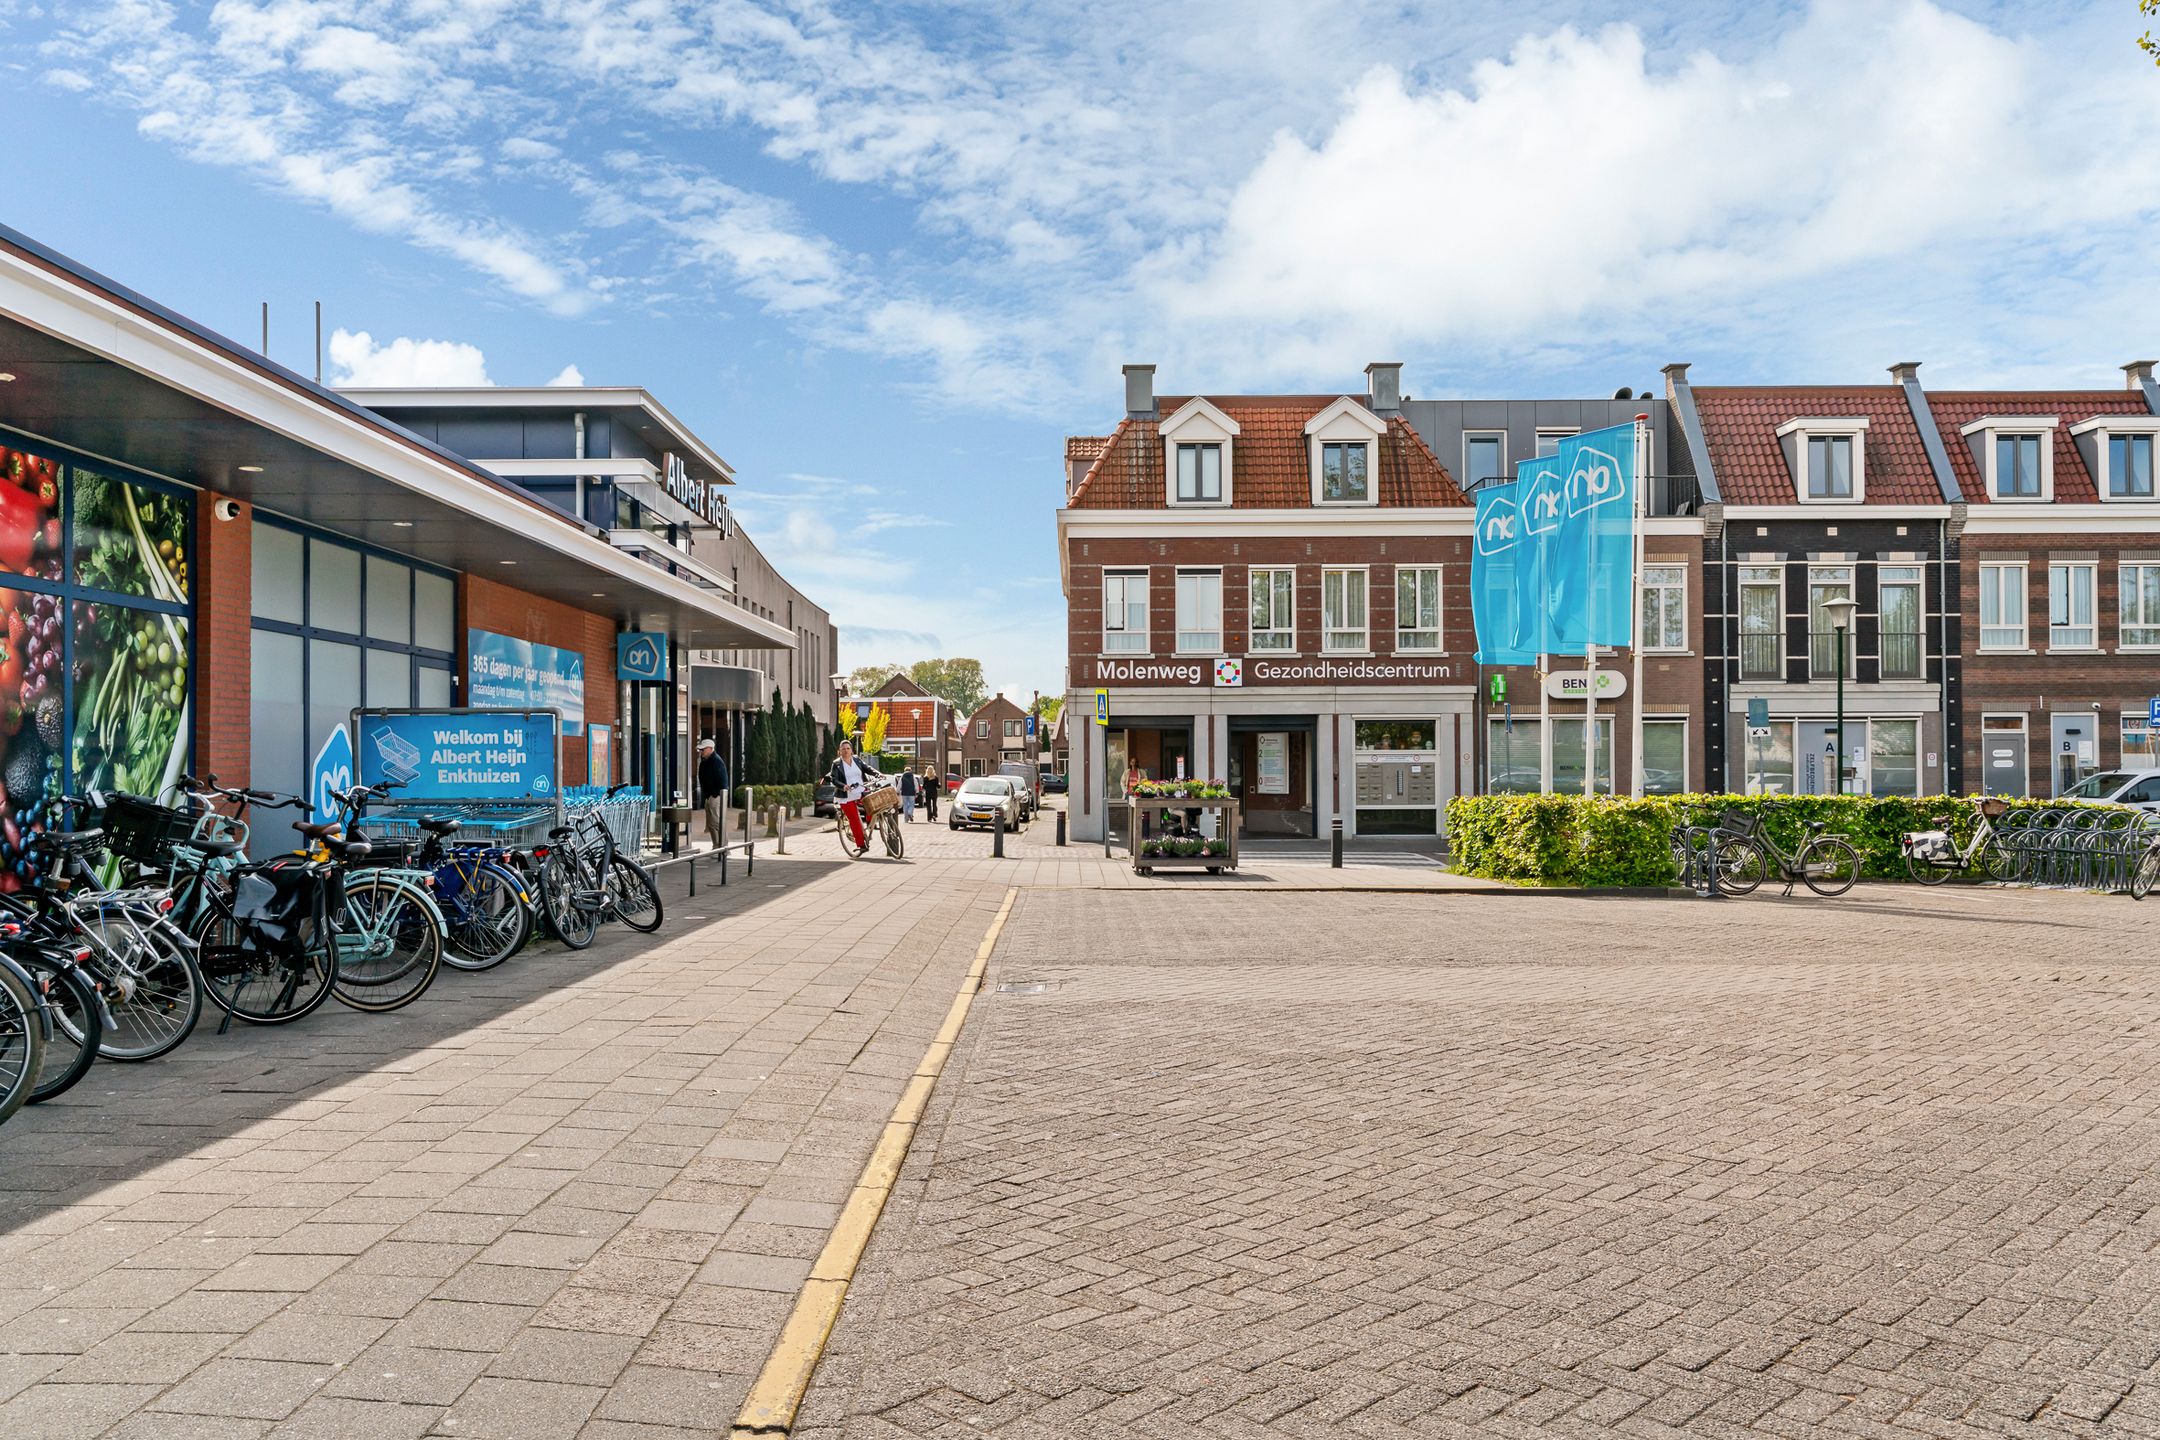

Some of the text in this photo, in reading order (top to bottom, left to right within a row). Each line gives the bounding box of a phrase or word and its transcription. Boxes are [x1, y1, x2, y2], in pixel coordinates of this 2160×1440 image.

[665, 452, 705, 517] Albert
[473, 654, 564, 687] 365 dagen per jaar geopend
[1097, 660, 1450, 684] Molenweg Gezondheidscentrum
[473, 683, 496, 699] maandag
[1562, 679, 1588, 689] BEN
[1027, 719, 1032, 733] P
[433, 729, 523, 747] Welkom bij
[2063, 741, 2071, 751] B
[1825, 742, 1835, 752] A
[431, 749, 527, 767] Albert Heijn
[438, 769, 520, 784] Enkhuizen
